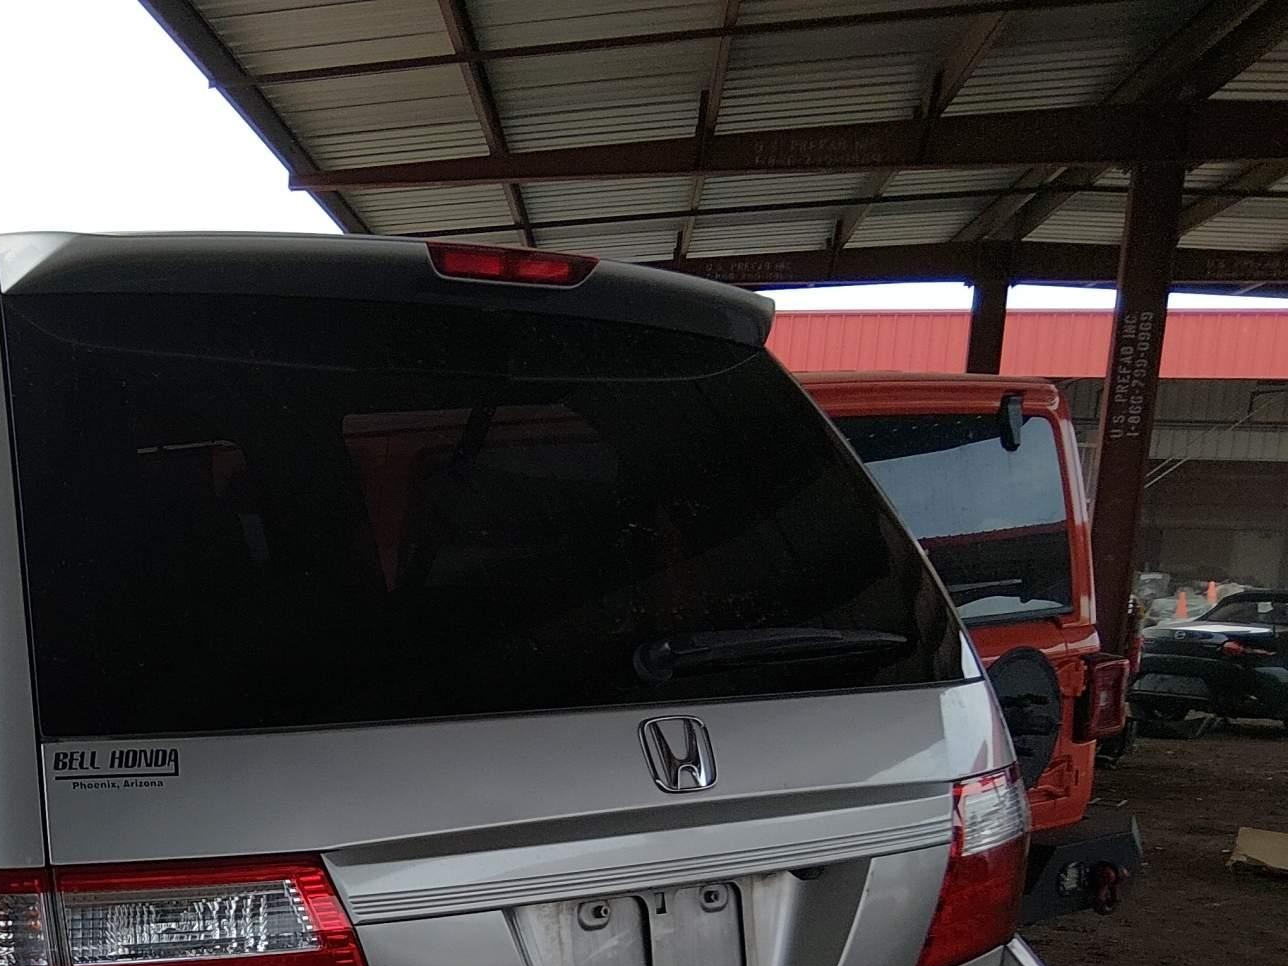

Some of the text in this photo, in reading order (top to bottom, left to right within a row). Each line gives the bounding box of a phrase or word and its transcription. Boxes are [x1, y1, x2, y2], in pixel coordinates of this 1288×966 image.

[53, 748, 179, 771] BELL HONDA
[72, 778, 164, 790] Phoenix, Arizona
